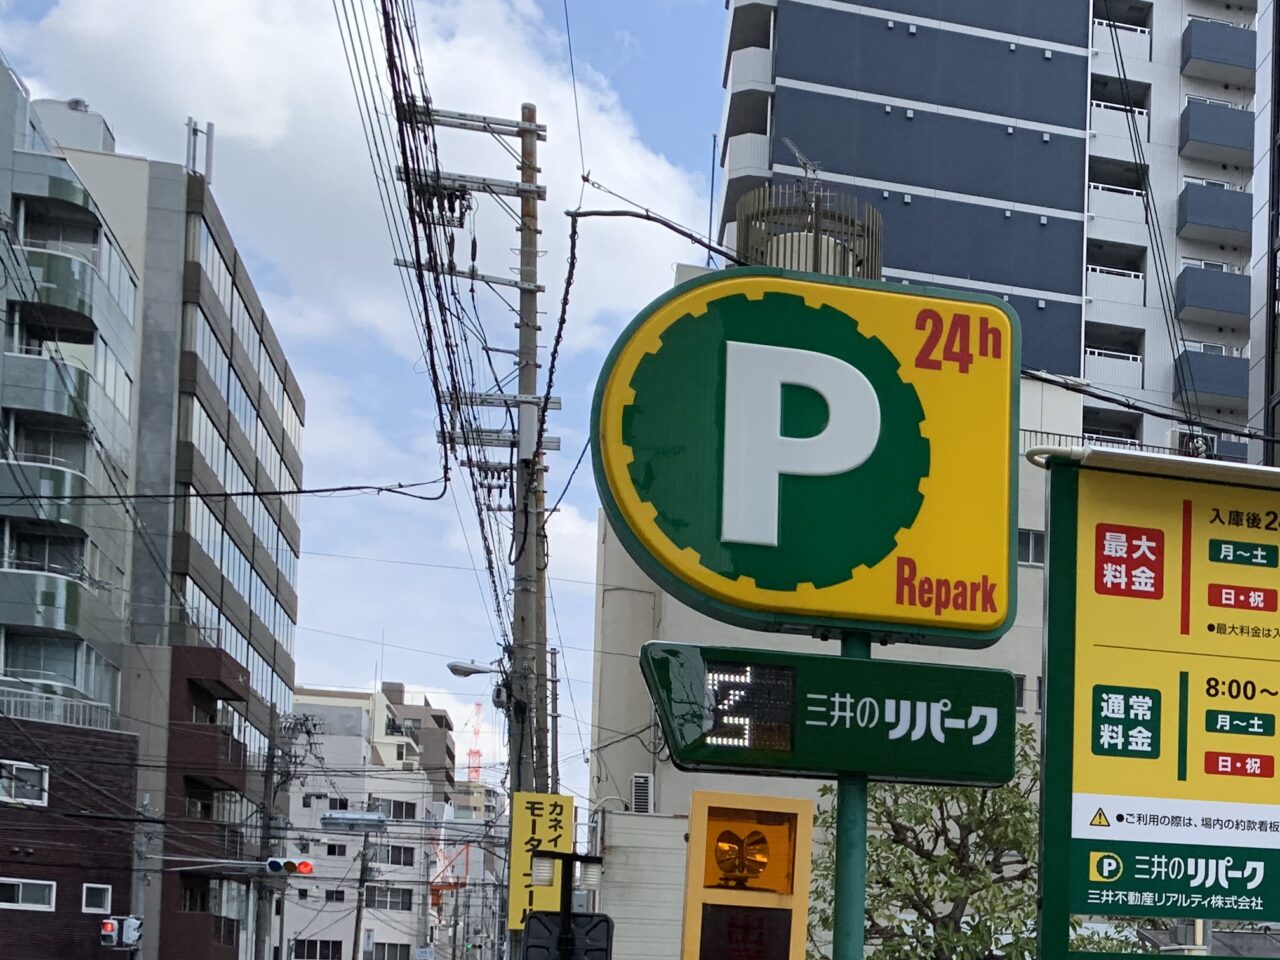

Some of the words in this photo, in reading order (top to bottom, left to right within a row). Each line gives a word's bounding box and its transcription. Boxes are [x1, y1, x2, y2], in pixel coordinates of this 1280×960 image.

[914, 308, 1002, 374] 24h
[721, 340, 882, 547] P
[1103, 532, 1157, 561] 最大
[895, 556, 998, 616] Repark
[1103, 563, 1156, 592] 料金
[805, 693, 998, 745] 三井のリパーク
[1101, 693, 1153, 721] 通常
[1100, 724, 1153, 752] 料金
[548, 801, 564, 848] カネイ
[1134, 854, 1265, 890] 三井のリパーク
[1087, 890, 1264, 910] 三井不動産リアルティ株式会社
